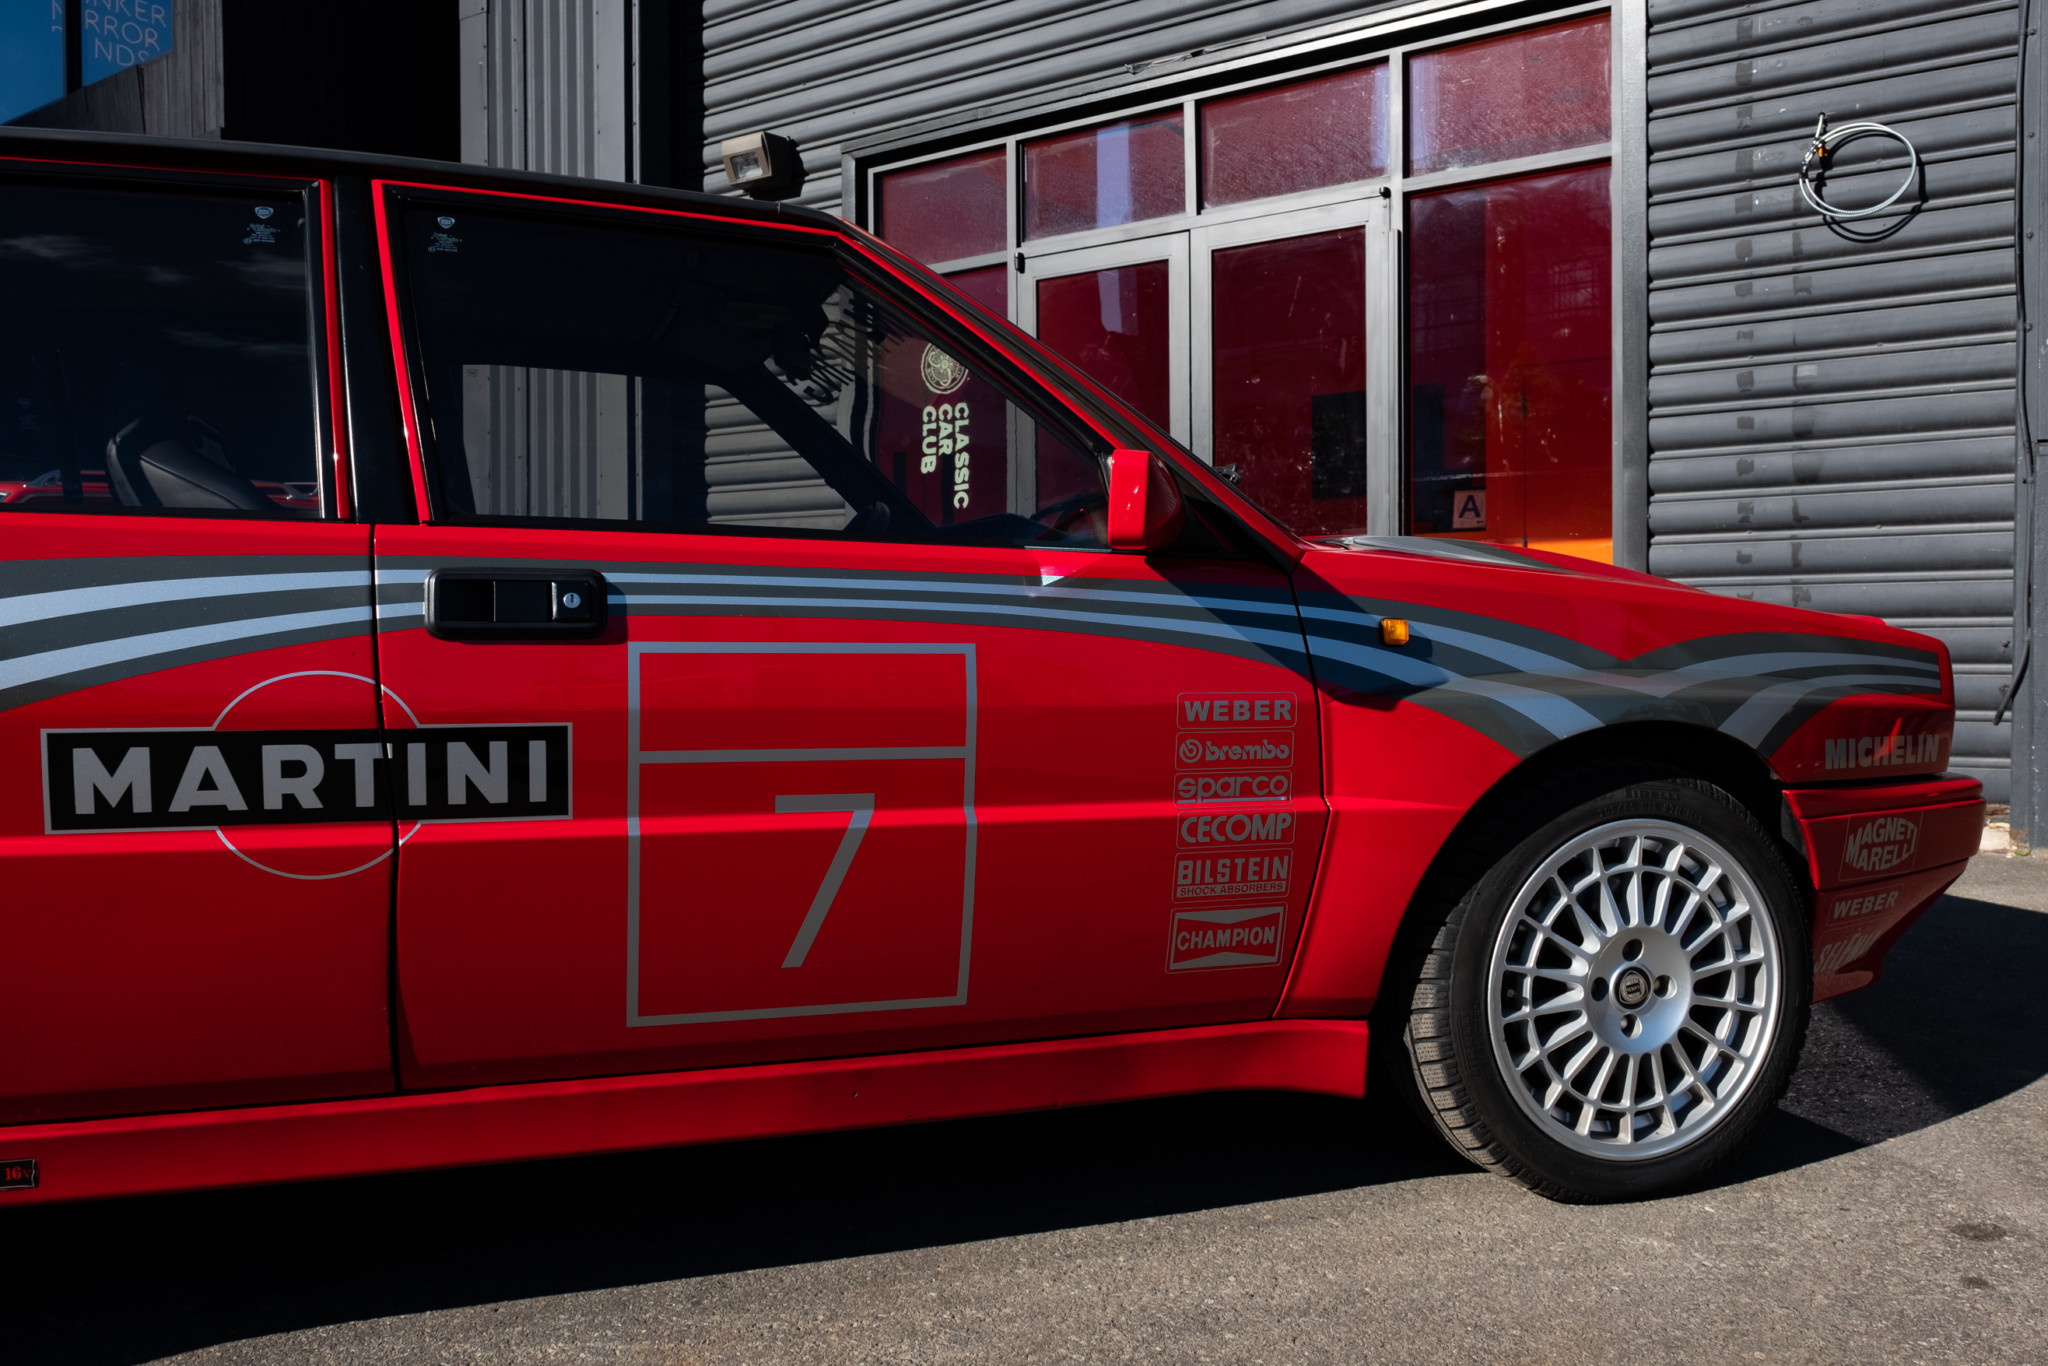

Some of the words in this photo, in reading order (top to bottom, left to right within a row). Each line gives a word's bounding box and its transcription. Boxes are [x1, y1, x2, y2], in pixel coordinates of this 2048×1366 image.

[920, 405, 937, 475] CLUB
[938, 403, 953, 456] CAR
[953, 402, 970, 510] CLASSIC
[1458, 494, 1481, 518] A
[1184, 699, 1292, 723] WEBER
[1205, 739, 1290, 761] brembo
[1825, 734, 1940, 770] MICHELIN
[71, 739, 549, 815] MARTINI
[1178, 774, 1288, 804] sparco
[1180, 812, 1292, 844] CECOMP
[1177, 855, 1289, 885] BILSTEIN
[1845, 840, 1918, 872] MARELLI
[774, 792, 875, 969] 7
[1180, 885, 1217, 896] SHOCK
[1219, 882, 1284, 894] ABSORBERS
[1833, 890, 1899, 919] WEBER
[1176, 925, 1275, 951] CHAMPION
